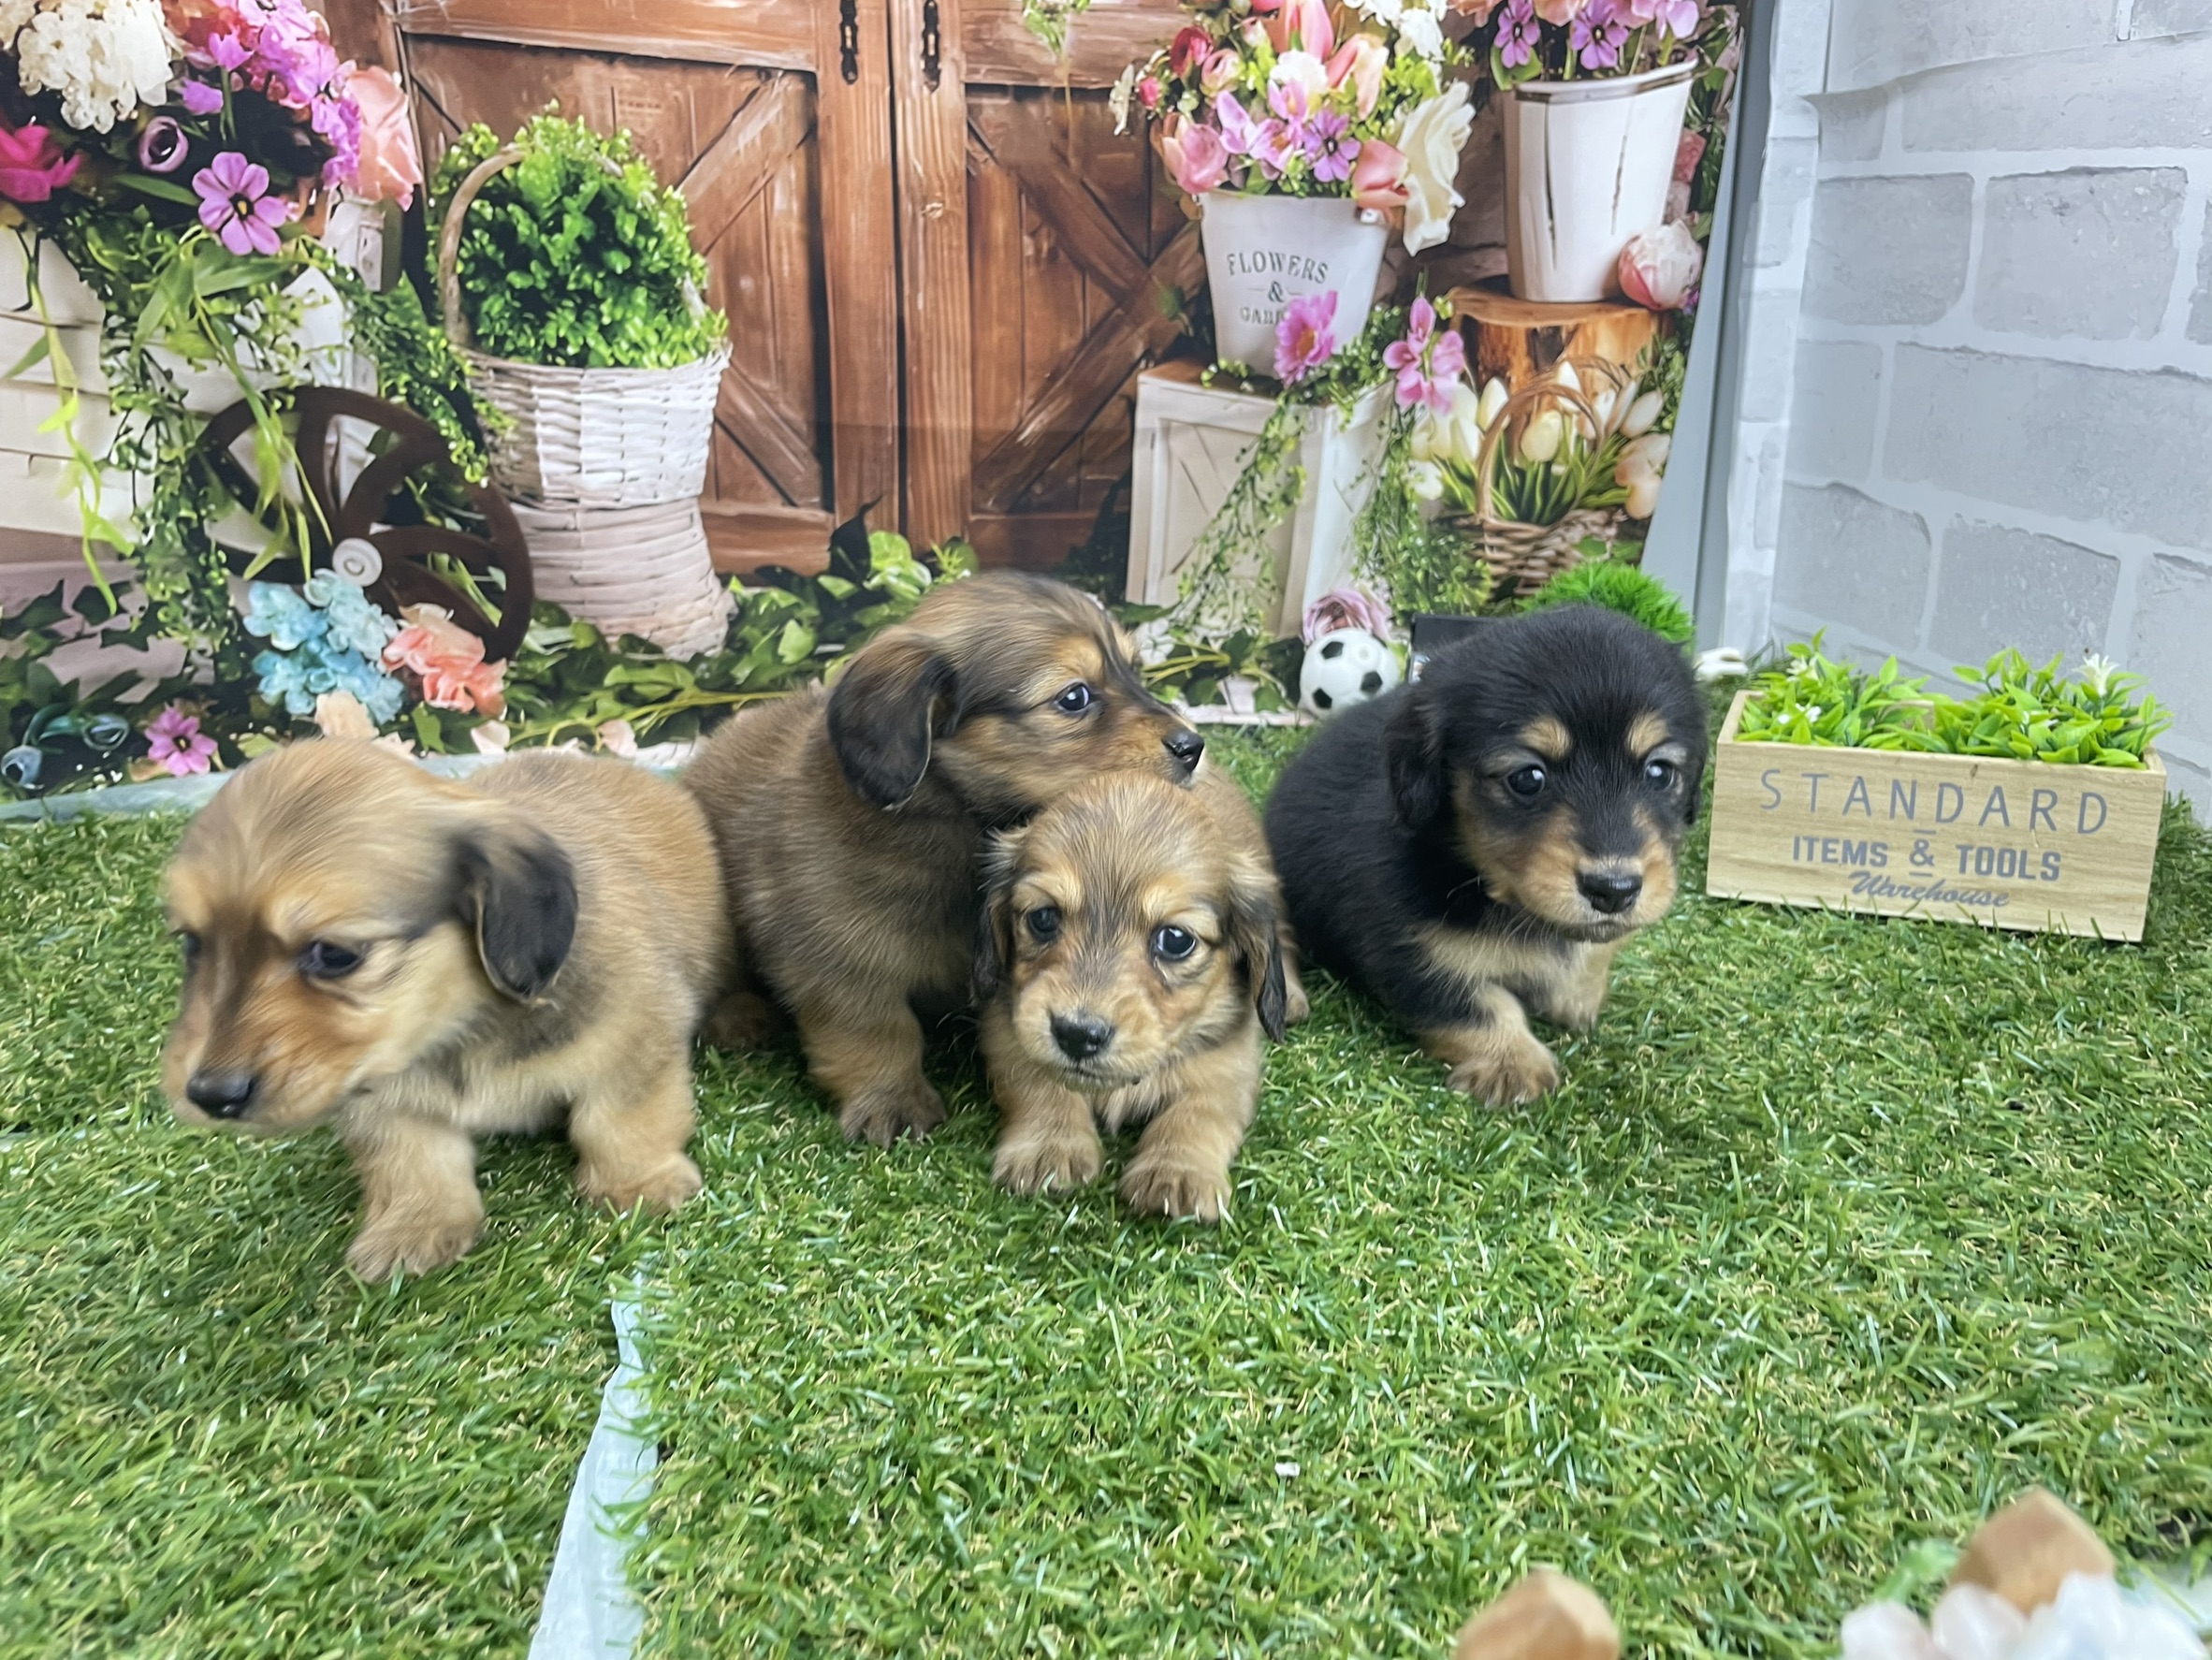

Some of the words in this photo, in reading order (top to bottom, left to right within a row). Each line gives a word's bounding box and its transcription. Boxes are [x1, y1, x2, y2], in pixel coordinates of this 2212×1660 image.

[1228, 251, 1328, 284] FLOWERS
[1267, 281, 1285, 302] &
[1760, 768, 2108, 835] STANDARD
[1792, 836, 1888, 867] ITEMS
[1908, 838, 1936, 867] &
[1956, 843, 2062, 881] TOOLS
[1847, 870, 2011, 908] Warehouse
